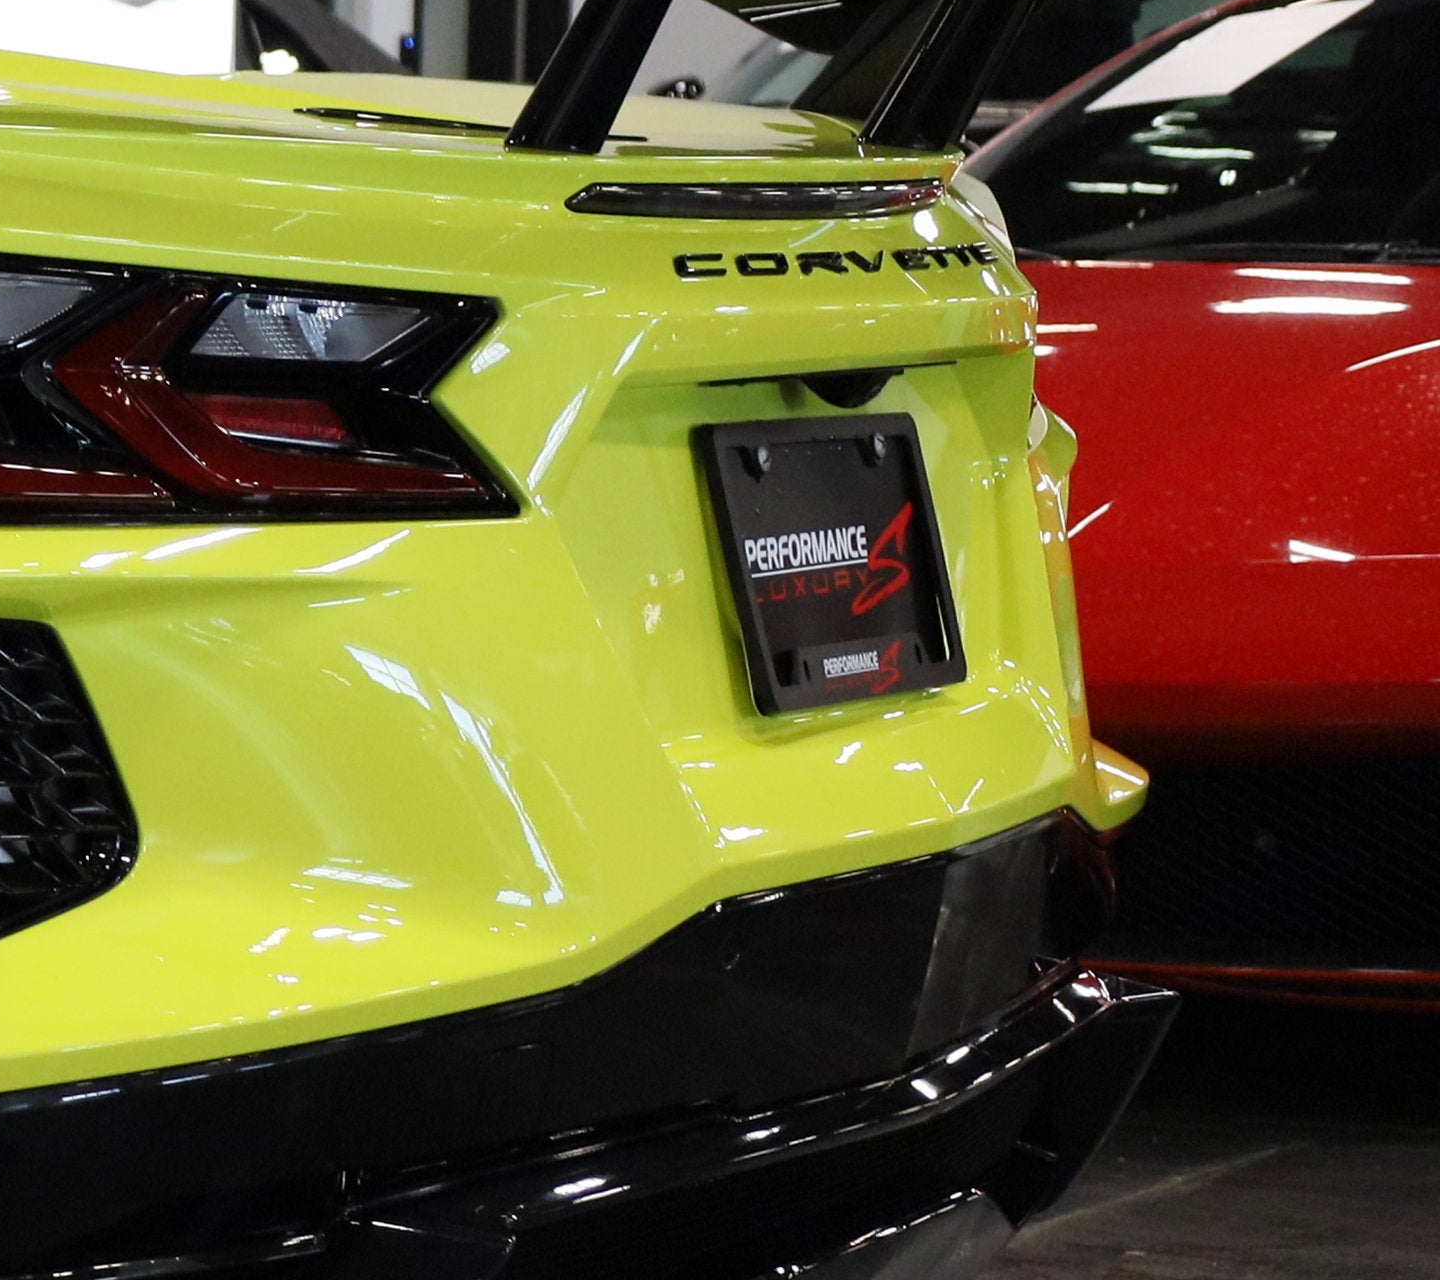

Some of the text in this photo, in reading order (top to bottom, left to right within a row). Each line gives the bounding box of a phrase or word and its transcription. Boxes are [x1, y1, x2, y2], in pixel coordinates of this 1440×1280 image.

[673, 240, 998, 278] CORVETTE
[744, 524, 869, 571] PERFORMANCE
[822, 649, 880, 677] PERFORMANCE
